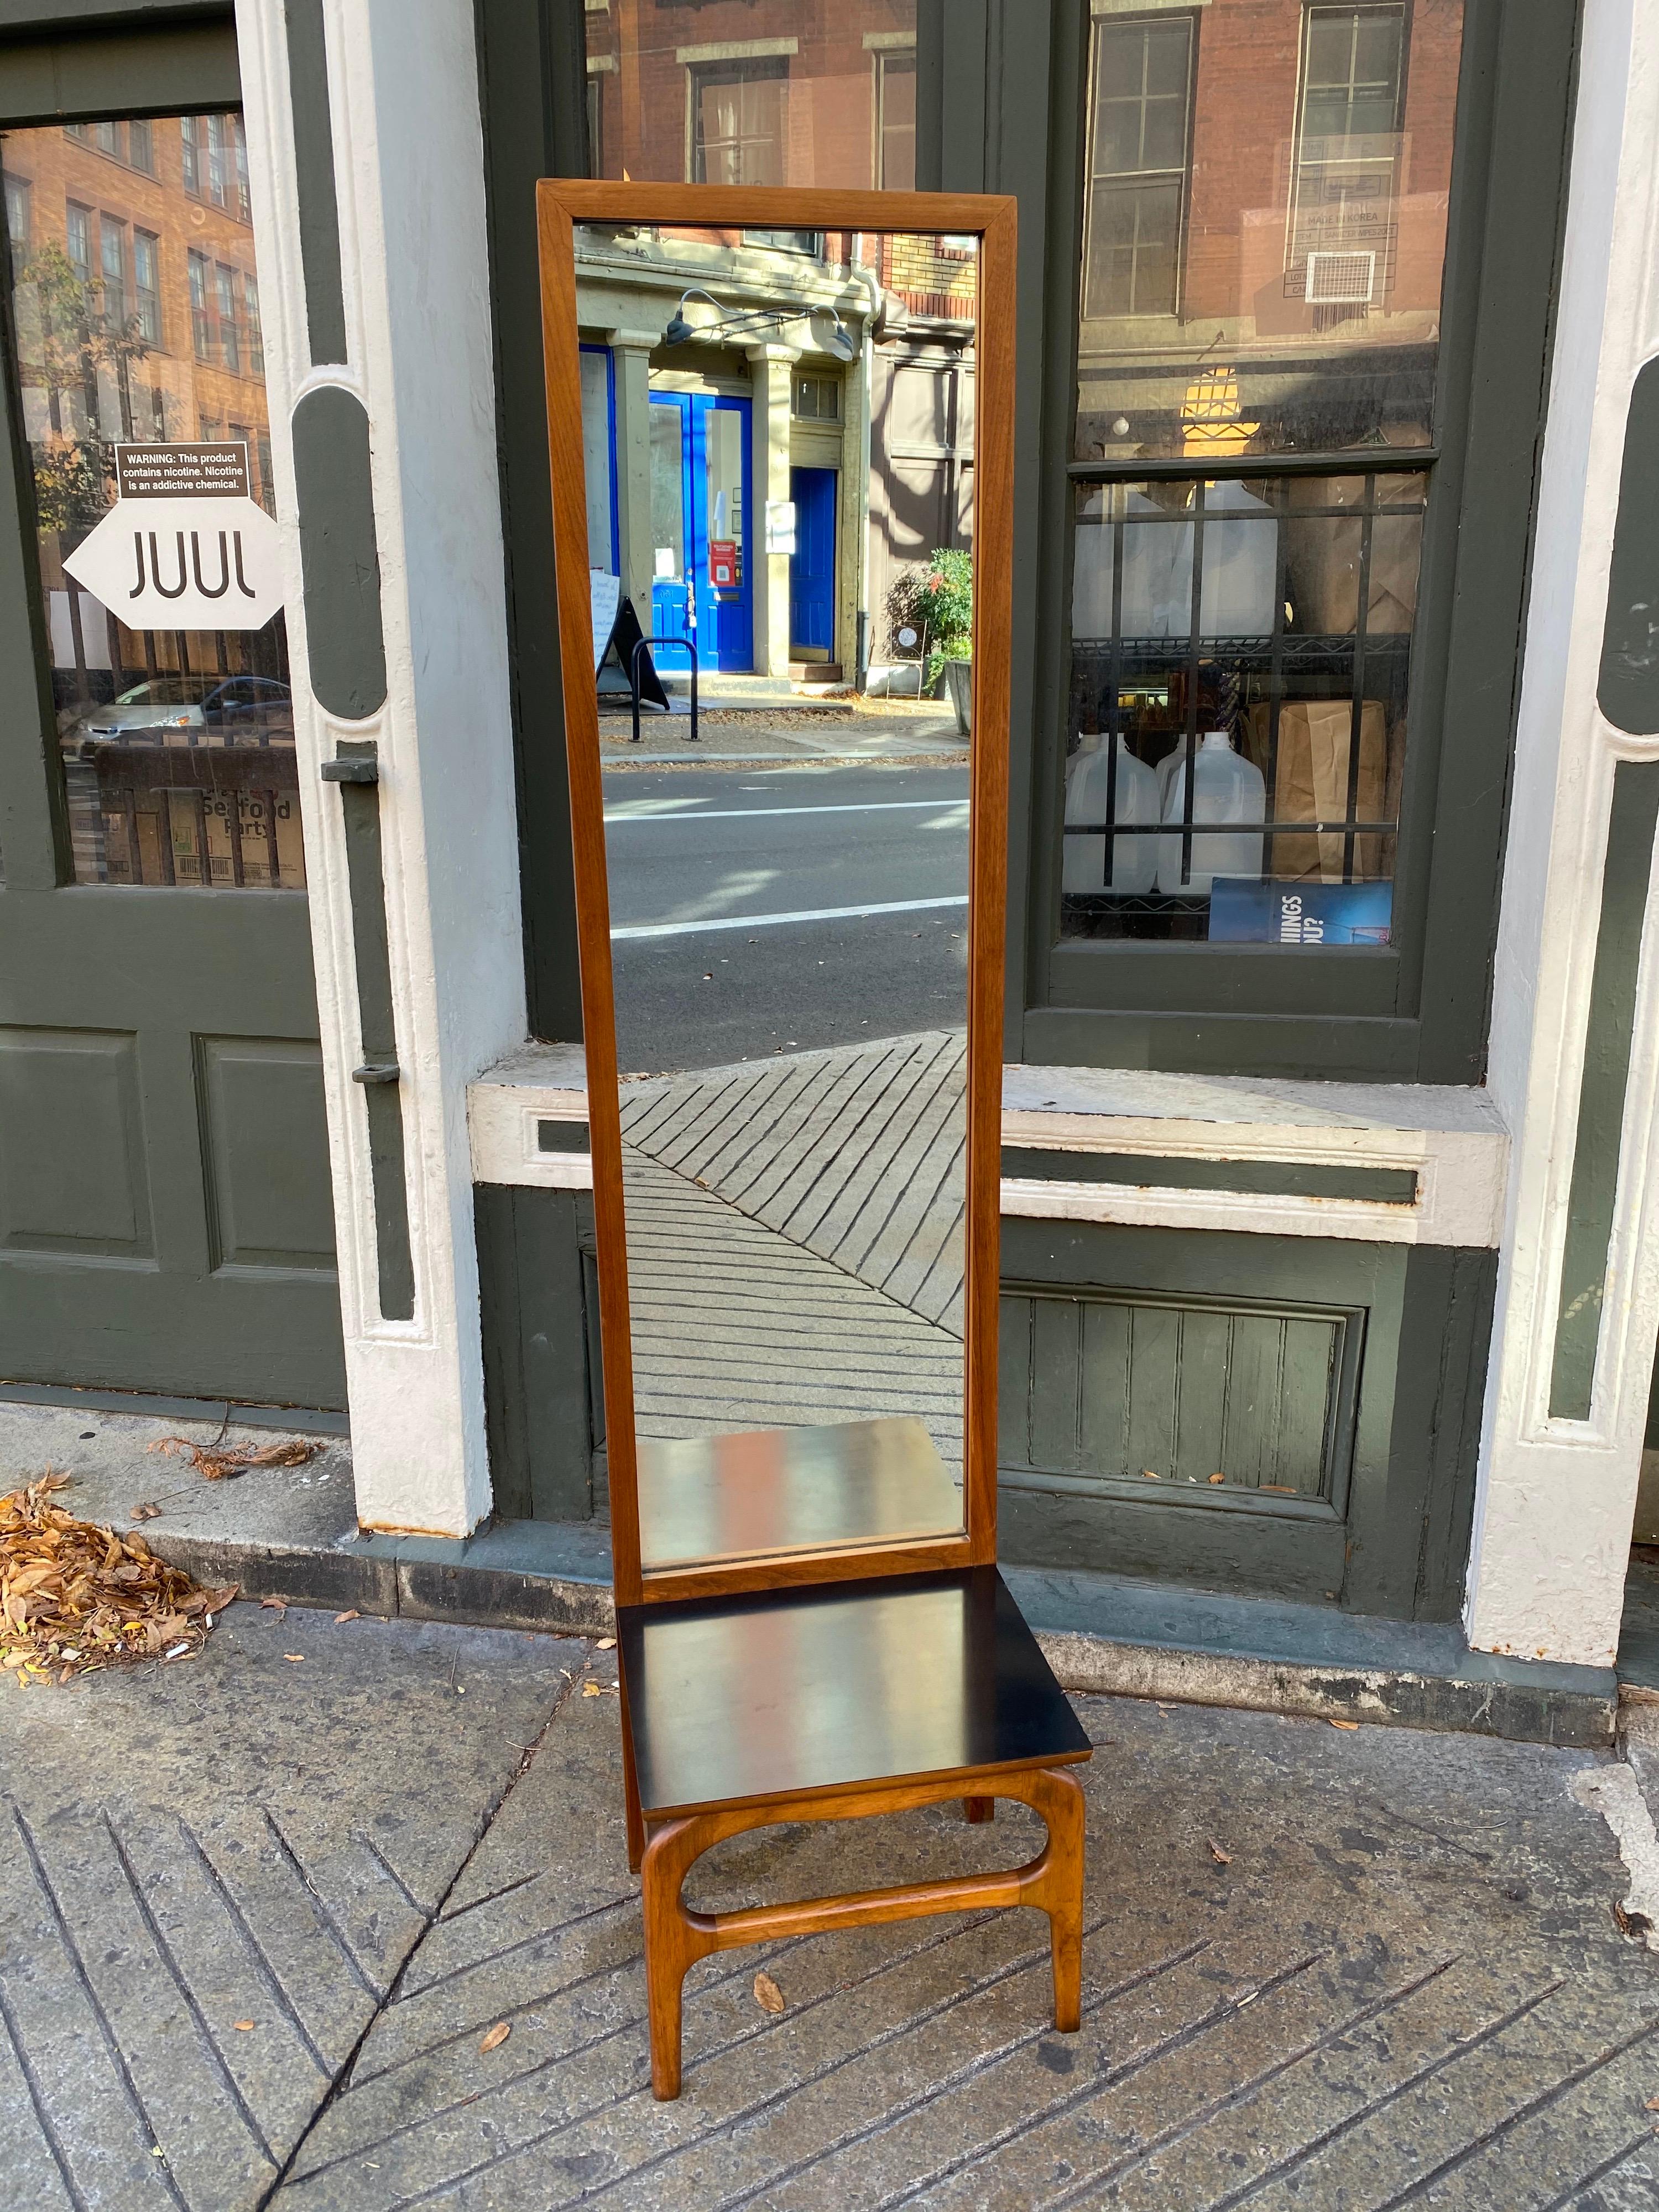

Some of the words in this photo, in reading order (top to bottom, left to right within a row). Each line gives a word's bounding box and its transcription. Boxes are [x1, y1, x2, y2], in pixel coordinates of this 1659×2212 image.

[1347, 212, 1378, 222] KOREA
[127, 454, 176, 464] WARNING:
[178, 453, 198, 463] This
[201, 453, 237, 465] product
[123, 467, 162, 477] contains
[164, 467, 203, 477] nicotine.
[205, 466, 243, 476] Nicotine
[128, 480, 137, 490] is
[139, 482, 150, 490] an
[153, 480, 194, 490] addictive
[195, 479, 239, 489] chemical.
[129, 531, 255, 599] JUUL
[202, 796, 291, 820] Sefod
